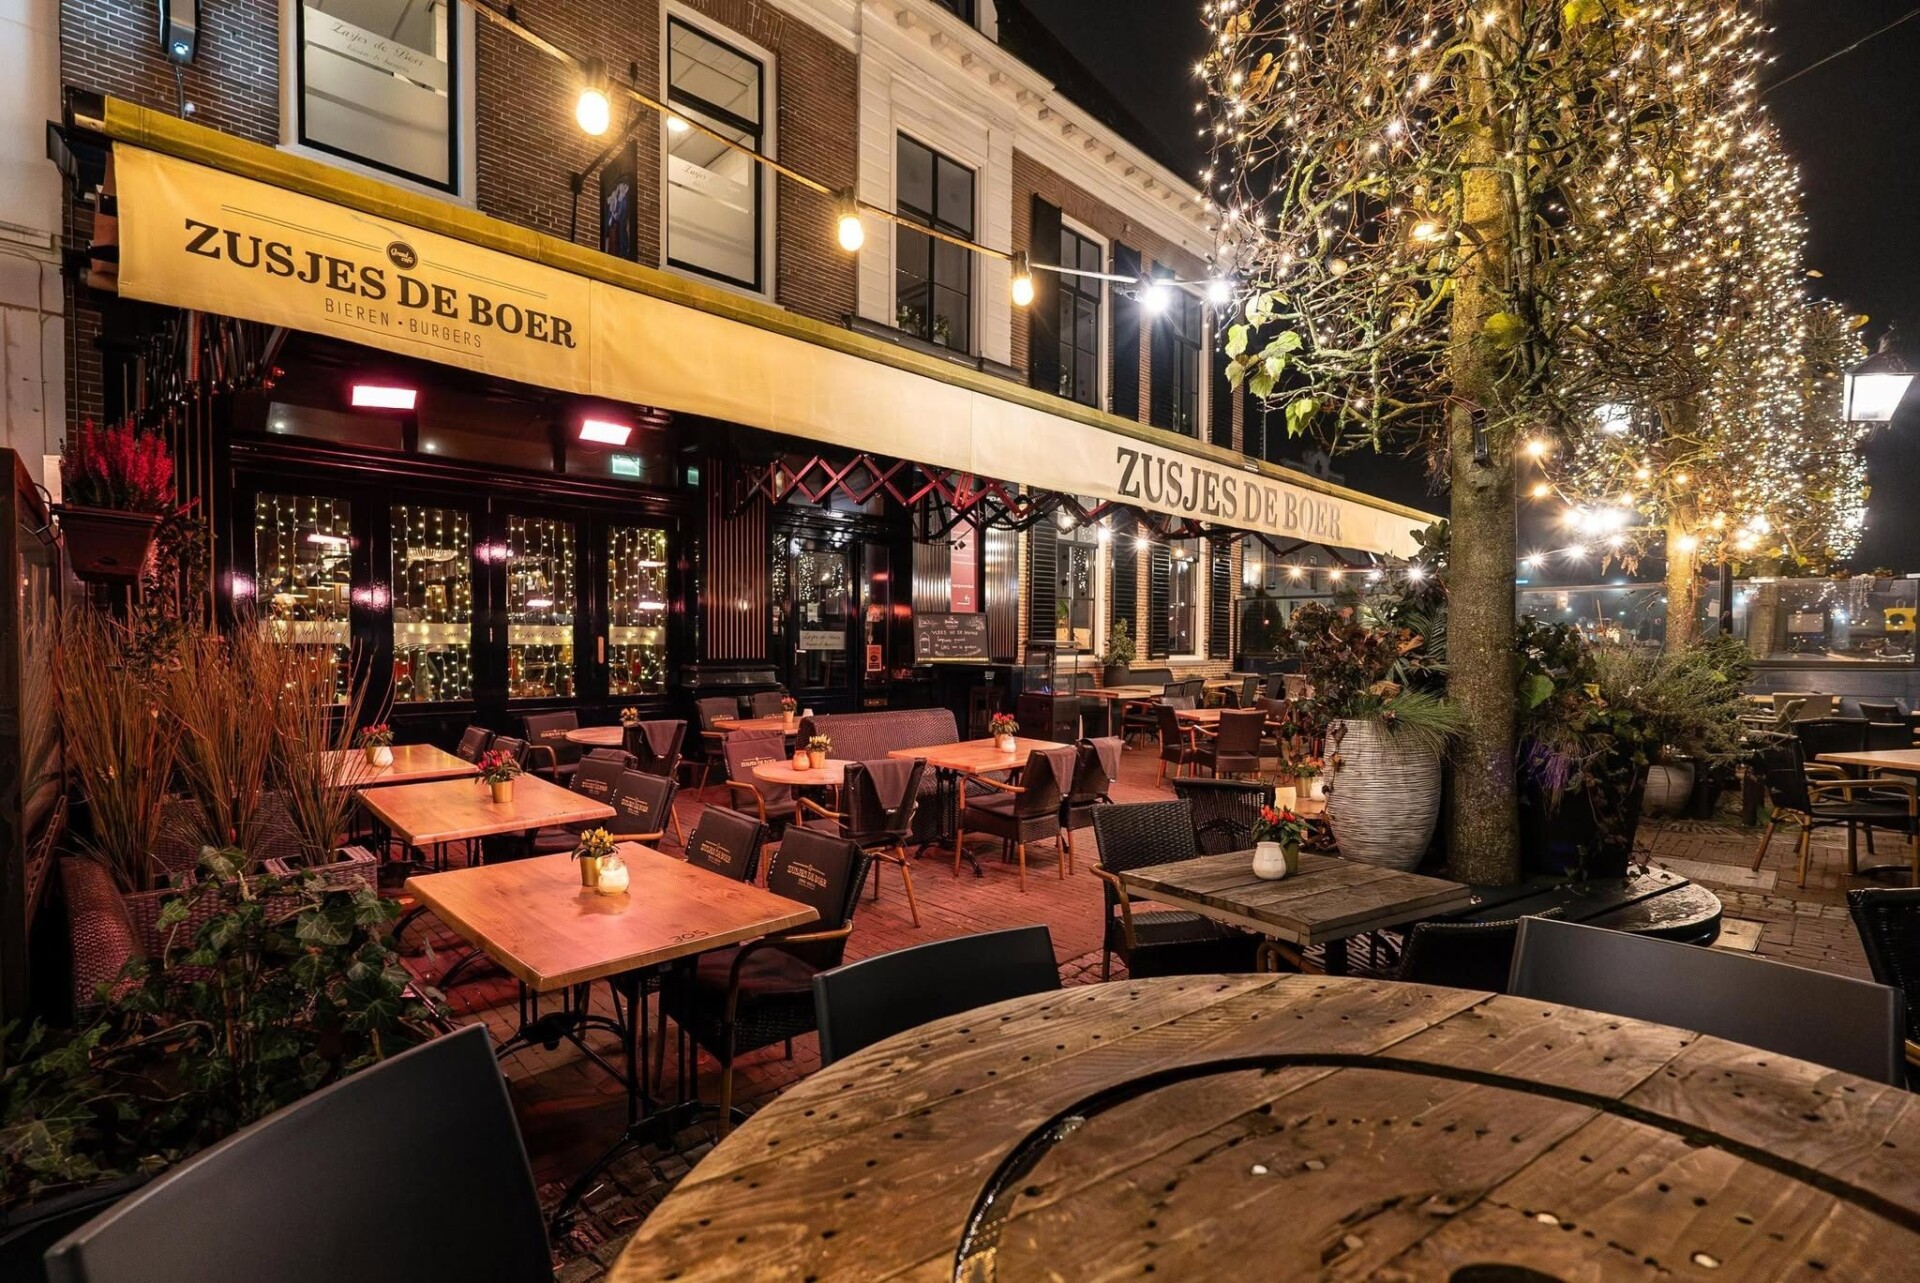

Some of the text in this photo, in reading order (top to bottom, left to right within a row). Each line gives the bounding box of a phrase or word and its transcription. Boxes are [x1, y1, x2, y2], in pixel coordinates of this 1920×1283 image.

[185, 218, 577, 349] ZUSJES DE BOER
[324, 297, 482, 348] BIEREN BURGERS
[1116, 446, 1344, 542] ZUSJES DE BOER
[668, 930, 709, 943] 305
